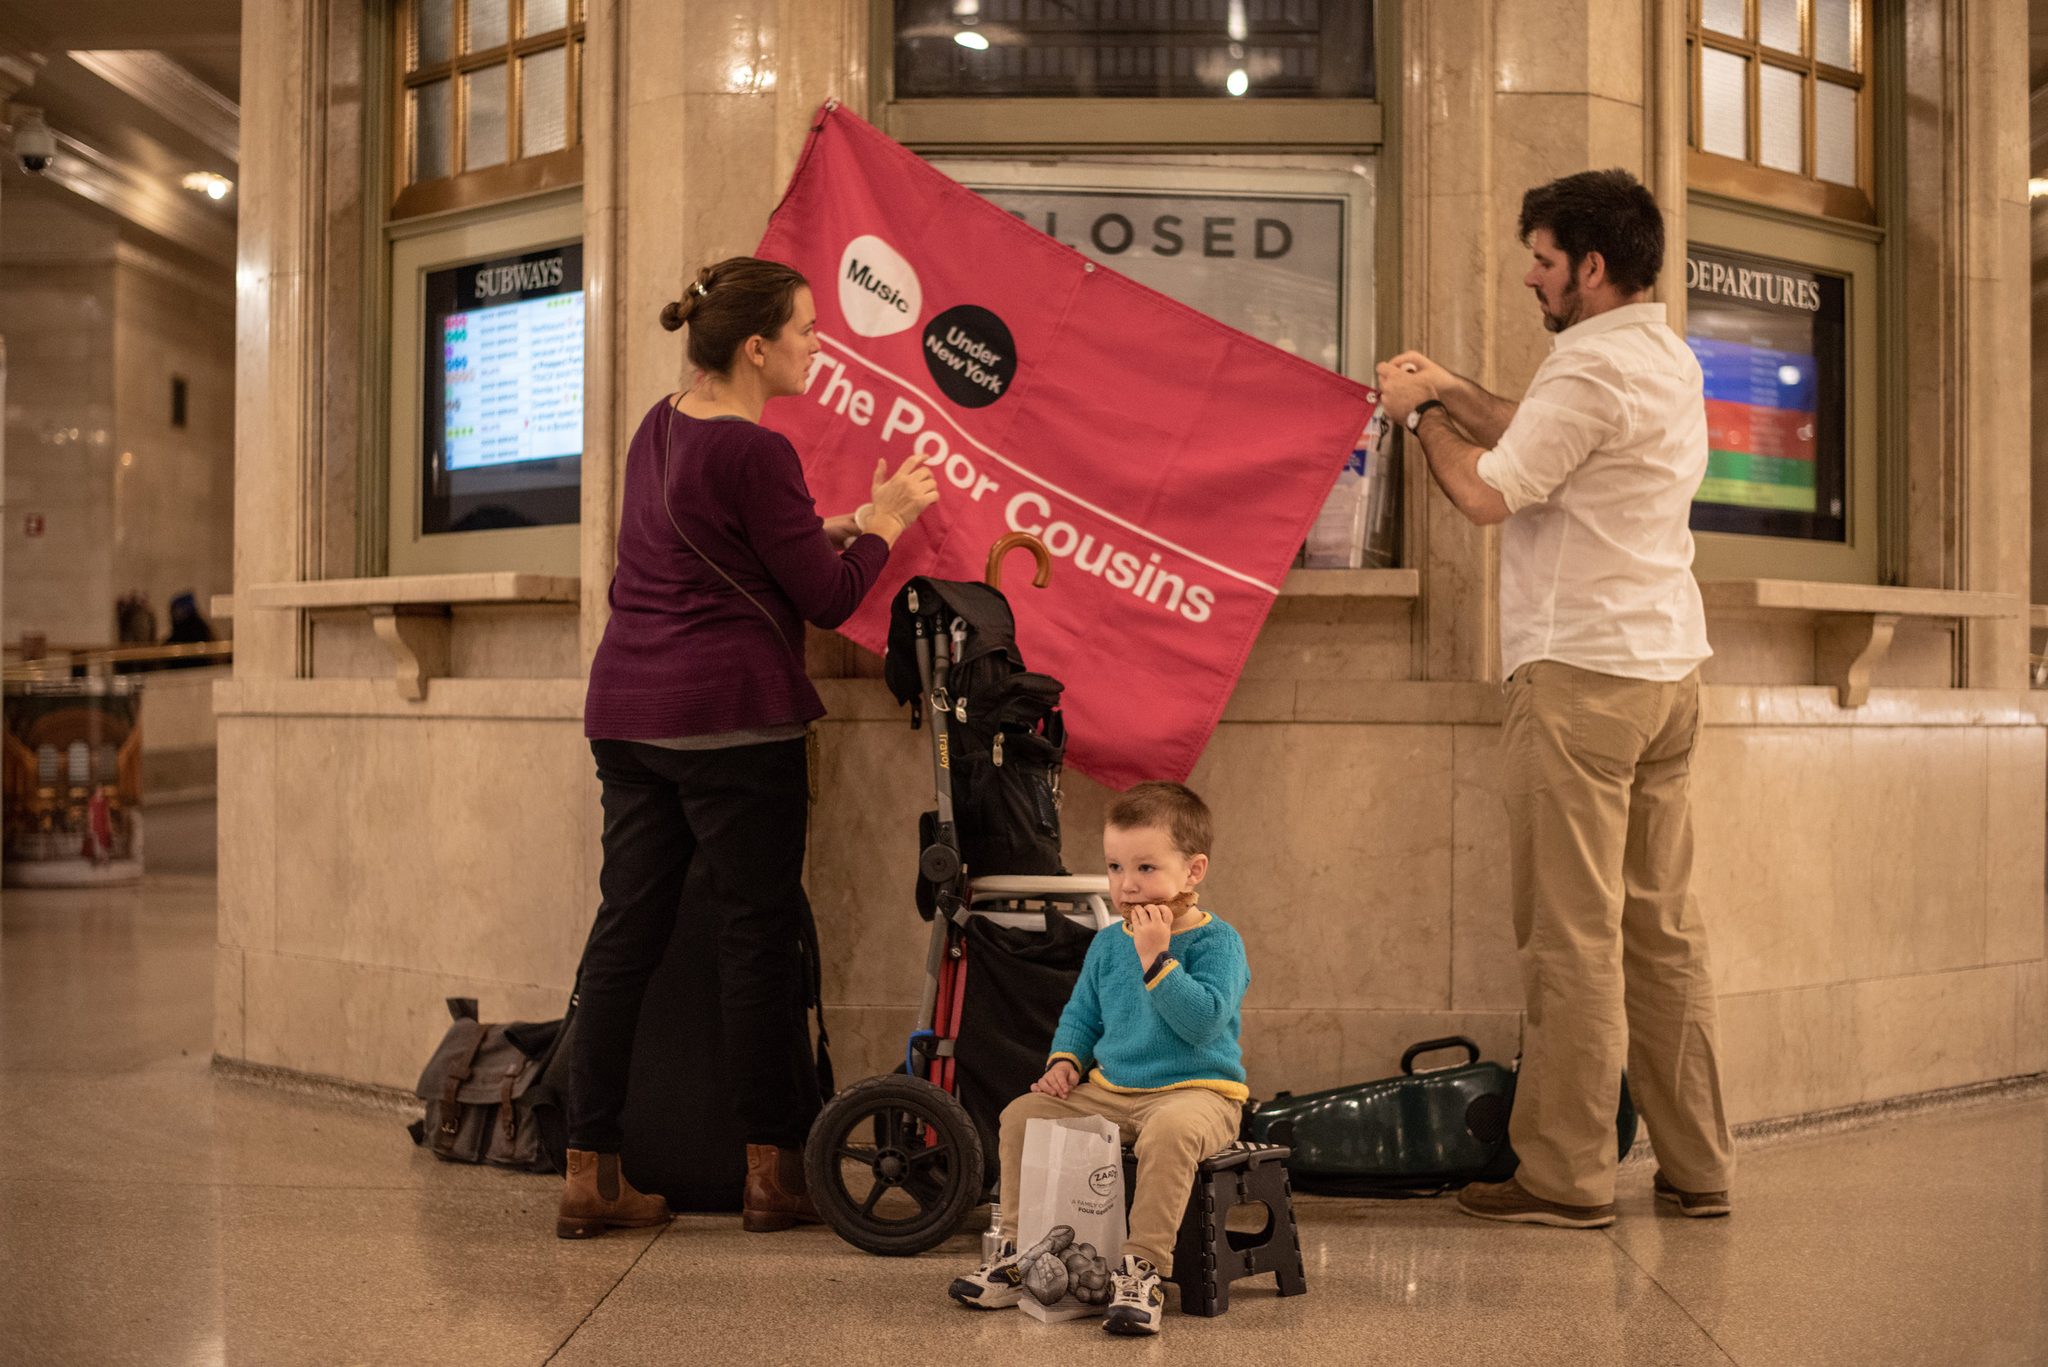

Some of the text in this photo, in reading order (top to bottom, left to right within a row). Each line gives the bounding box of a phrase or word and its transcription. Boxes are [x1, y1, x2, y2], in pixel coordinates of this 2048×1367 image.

[1009, 210, 1294, 260] LOSED
[474, 256, 564, 299] SUBWAYS
[846, 258, 910, 314] Music
[1687, 257, 1821, 312] DEPARTURES
[925, 334, 1004, 395] New York
[946, 325, 1002, 368] Under
[803, 351, 1217, 624] The Poor Cousins
[938, 730, 950, 769] Travoy
